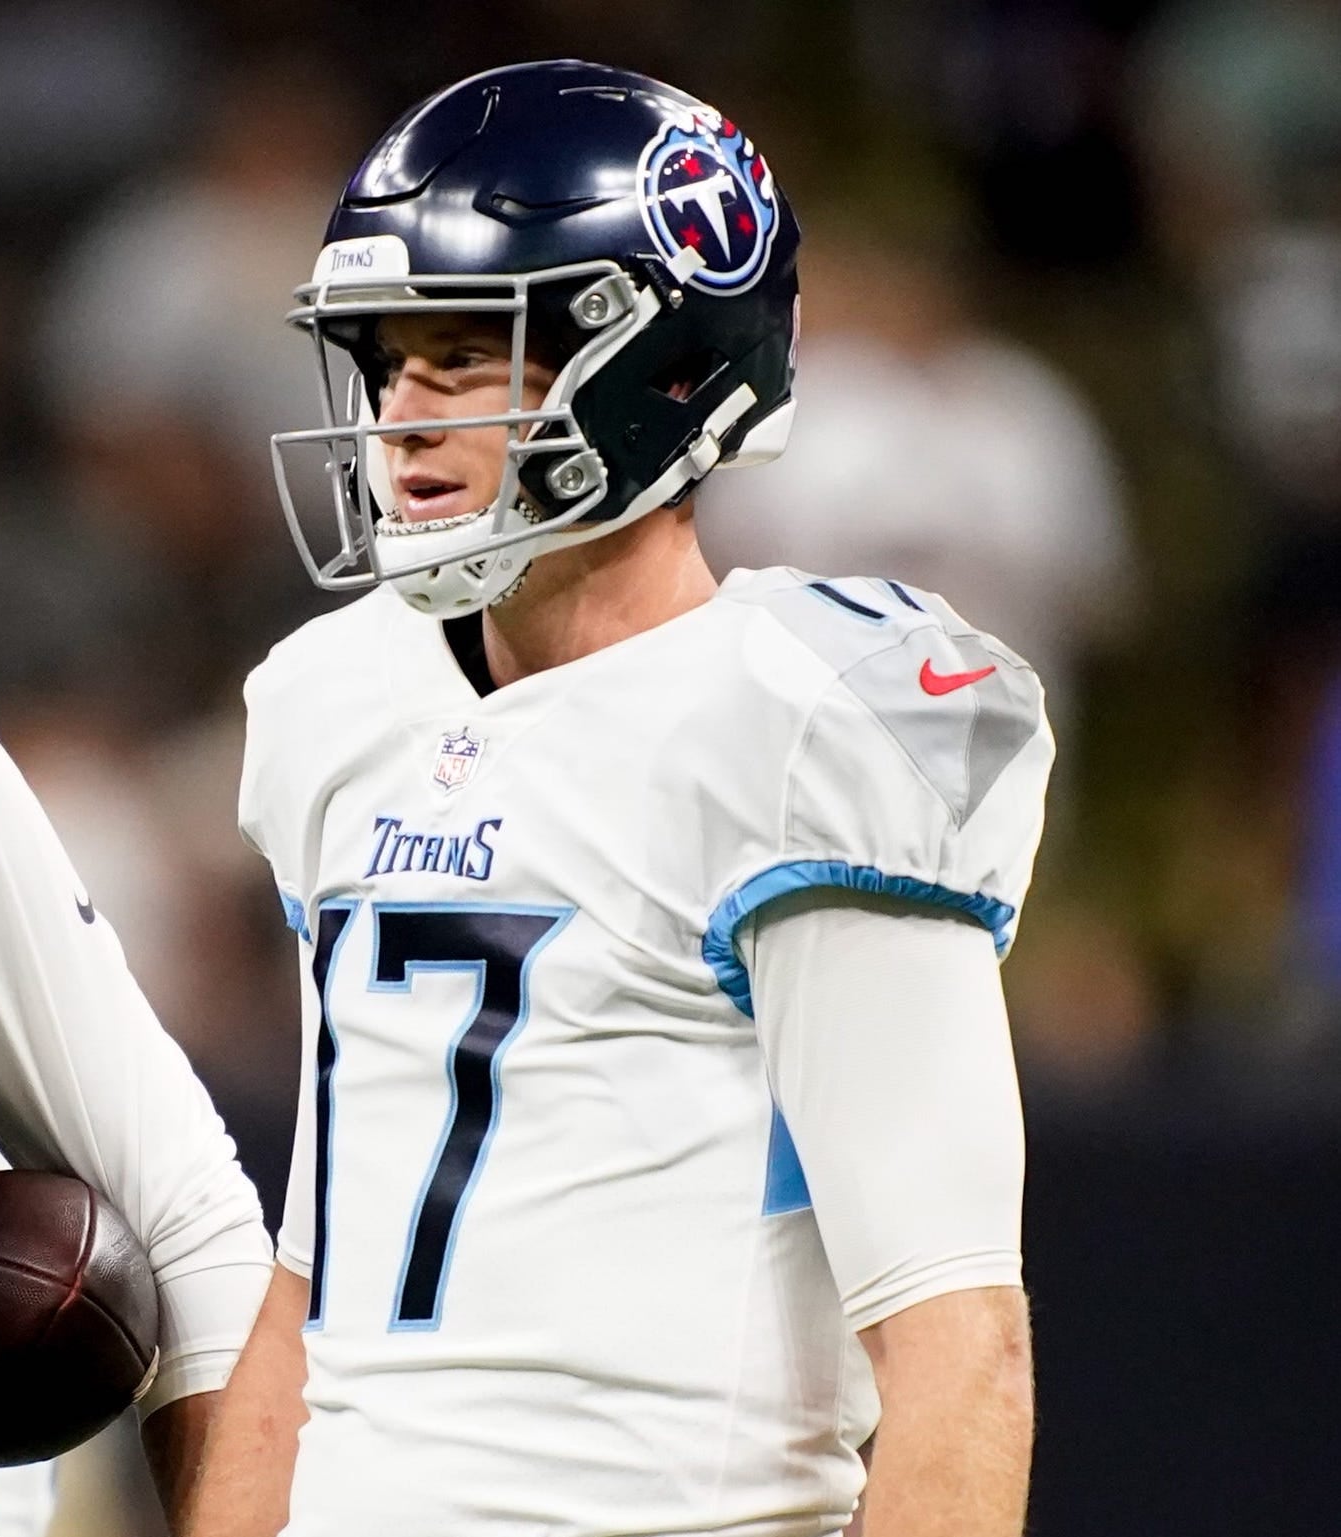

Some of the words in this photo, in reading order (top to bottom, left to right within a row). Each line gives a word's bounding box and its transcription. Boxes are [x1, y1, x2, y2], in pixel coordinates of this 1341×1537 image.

[331, 245, 376, 273] TITANS
[362, 814, 504, 882] TITANS
[302, 898, 581, 1333] 17
